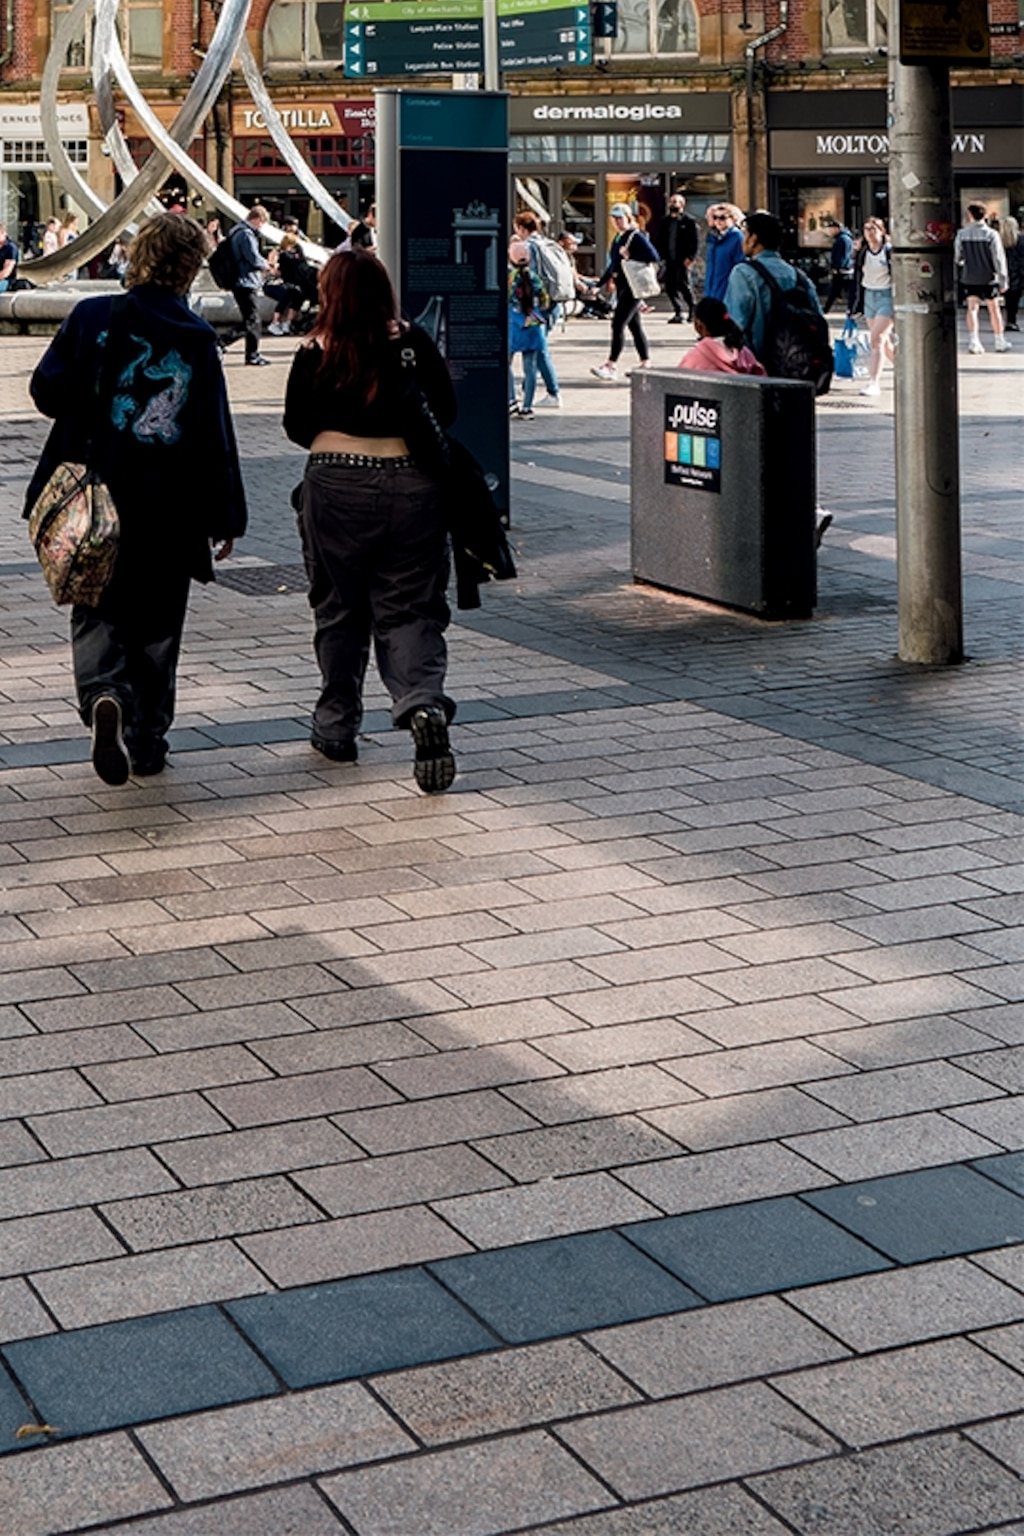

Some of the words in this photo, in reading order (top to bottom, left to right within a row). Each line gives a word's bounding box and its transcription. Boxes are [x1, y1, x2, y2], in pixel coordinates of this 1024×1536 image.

[454, 23, 479, 31] Station
[433, 42, 454, 50] Police
[455, 41, 480, 50] Station
[455, 60, 480, 69] Station
[244, 109, 331, 128] TOTILLA
[533, 104, 682, 121] dermalogica
[669, 401, 718, 428] pulse
